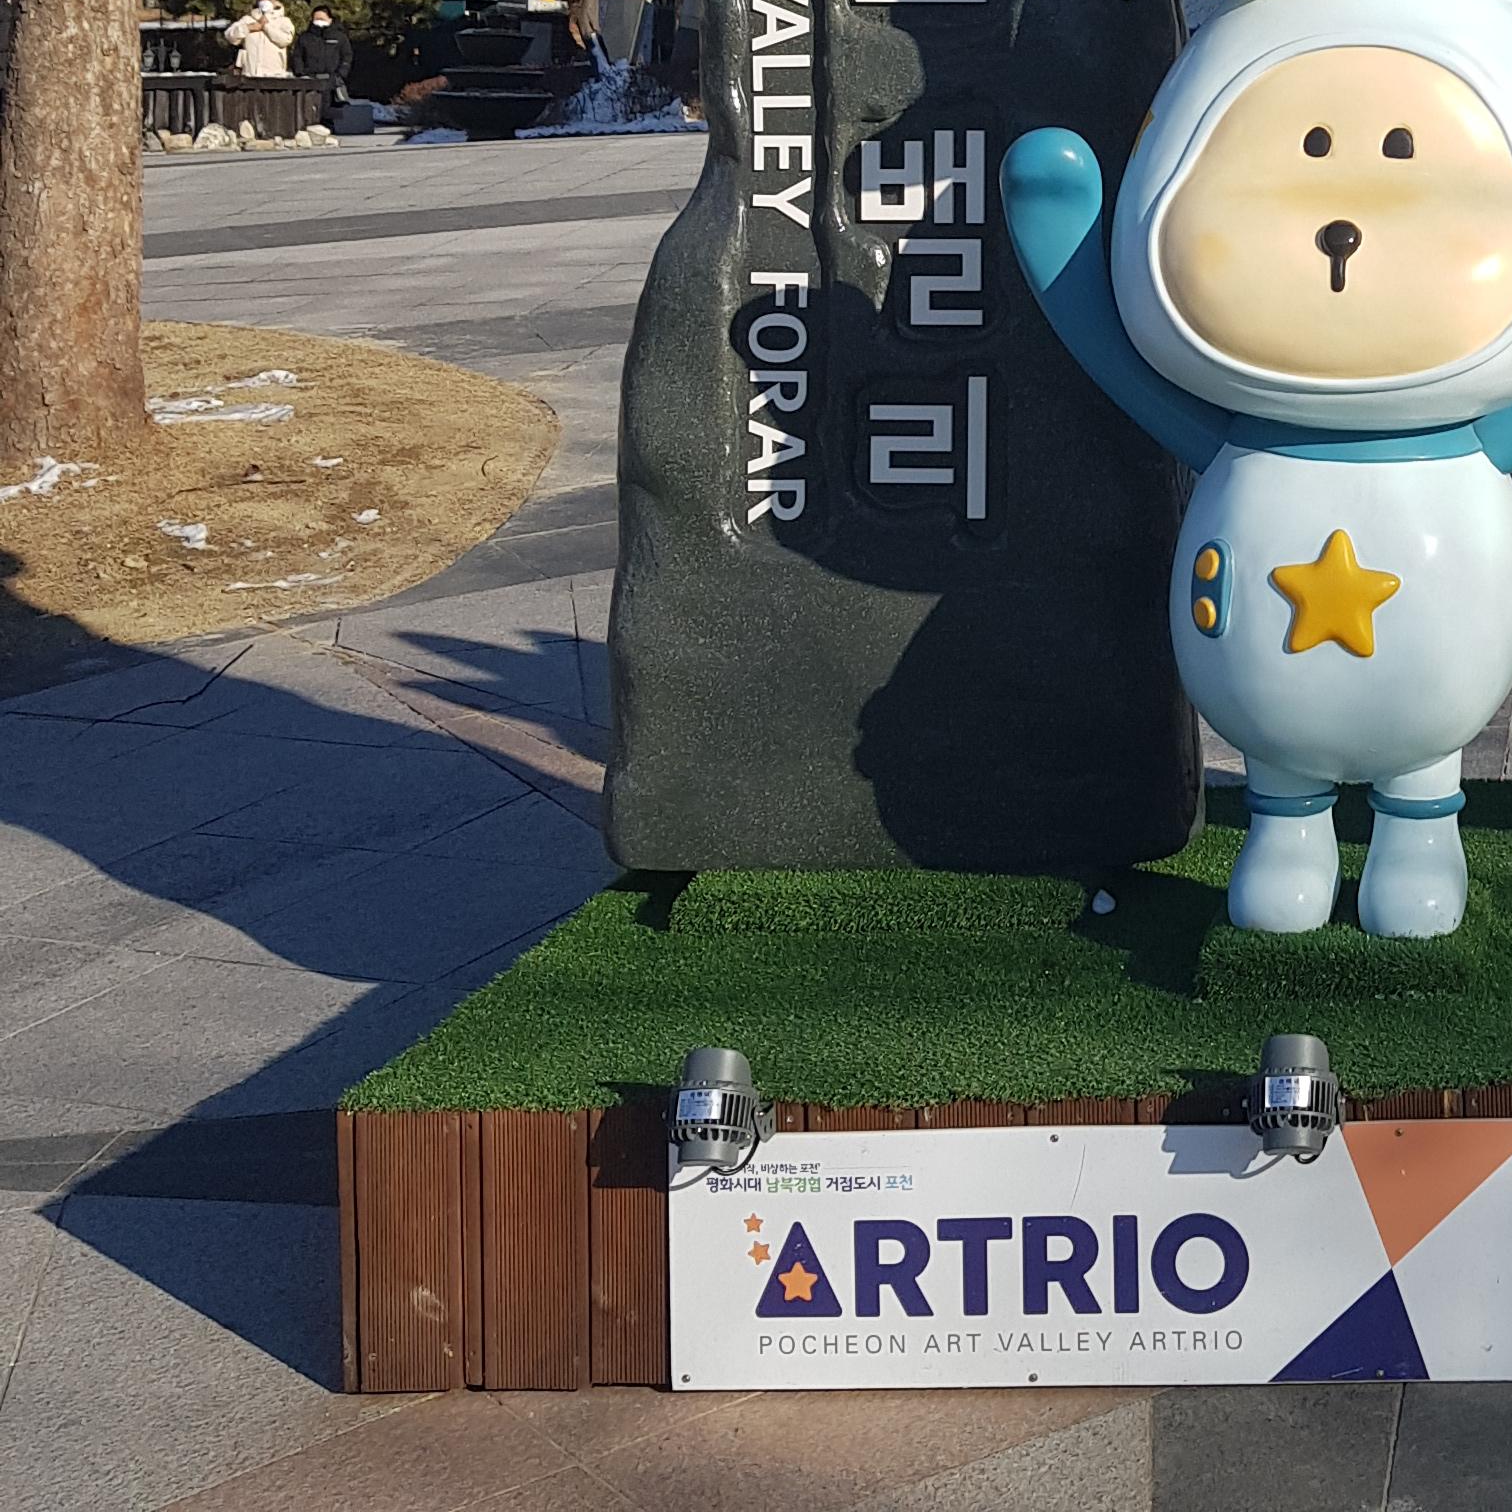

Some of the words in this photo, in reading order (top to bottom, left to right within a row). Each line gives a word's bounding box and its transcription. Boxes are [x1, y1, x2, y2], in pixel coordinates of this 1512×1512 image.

[745, 270, 810, 525] FORAR
[760, 1163, 798, 1175] 비상하는
[706, 1177, 762, 1193] 평화시대
[825, 1175, 881, 1193] 거점도시
[884, 1174, 914, 1191] 포천
[756, 1212, 1250, 1318] ARTRIO
[758, 1334, 908, 1356] POCHEON
[923, 1333, 981, 1355] ART
[996, 1332, 1114, 1354] VALLEY
[1129, 1330, 1245, 1352] ARTRIO
